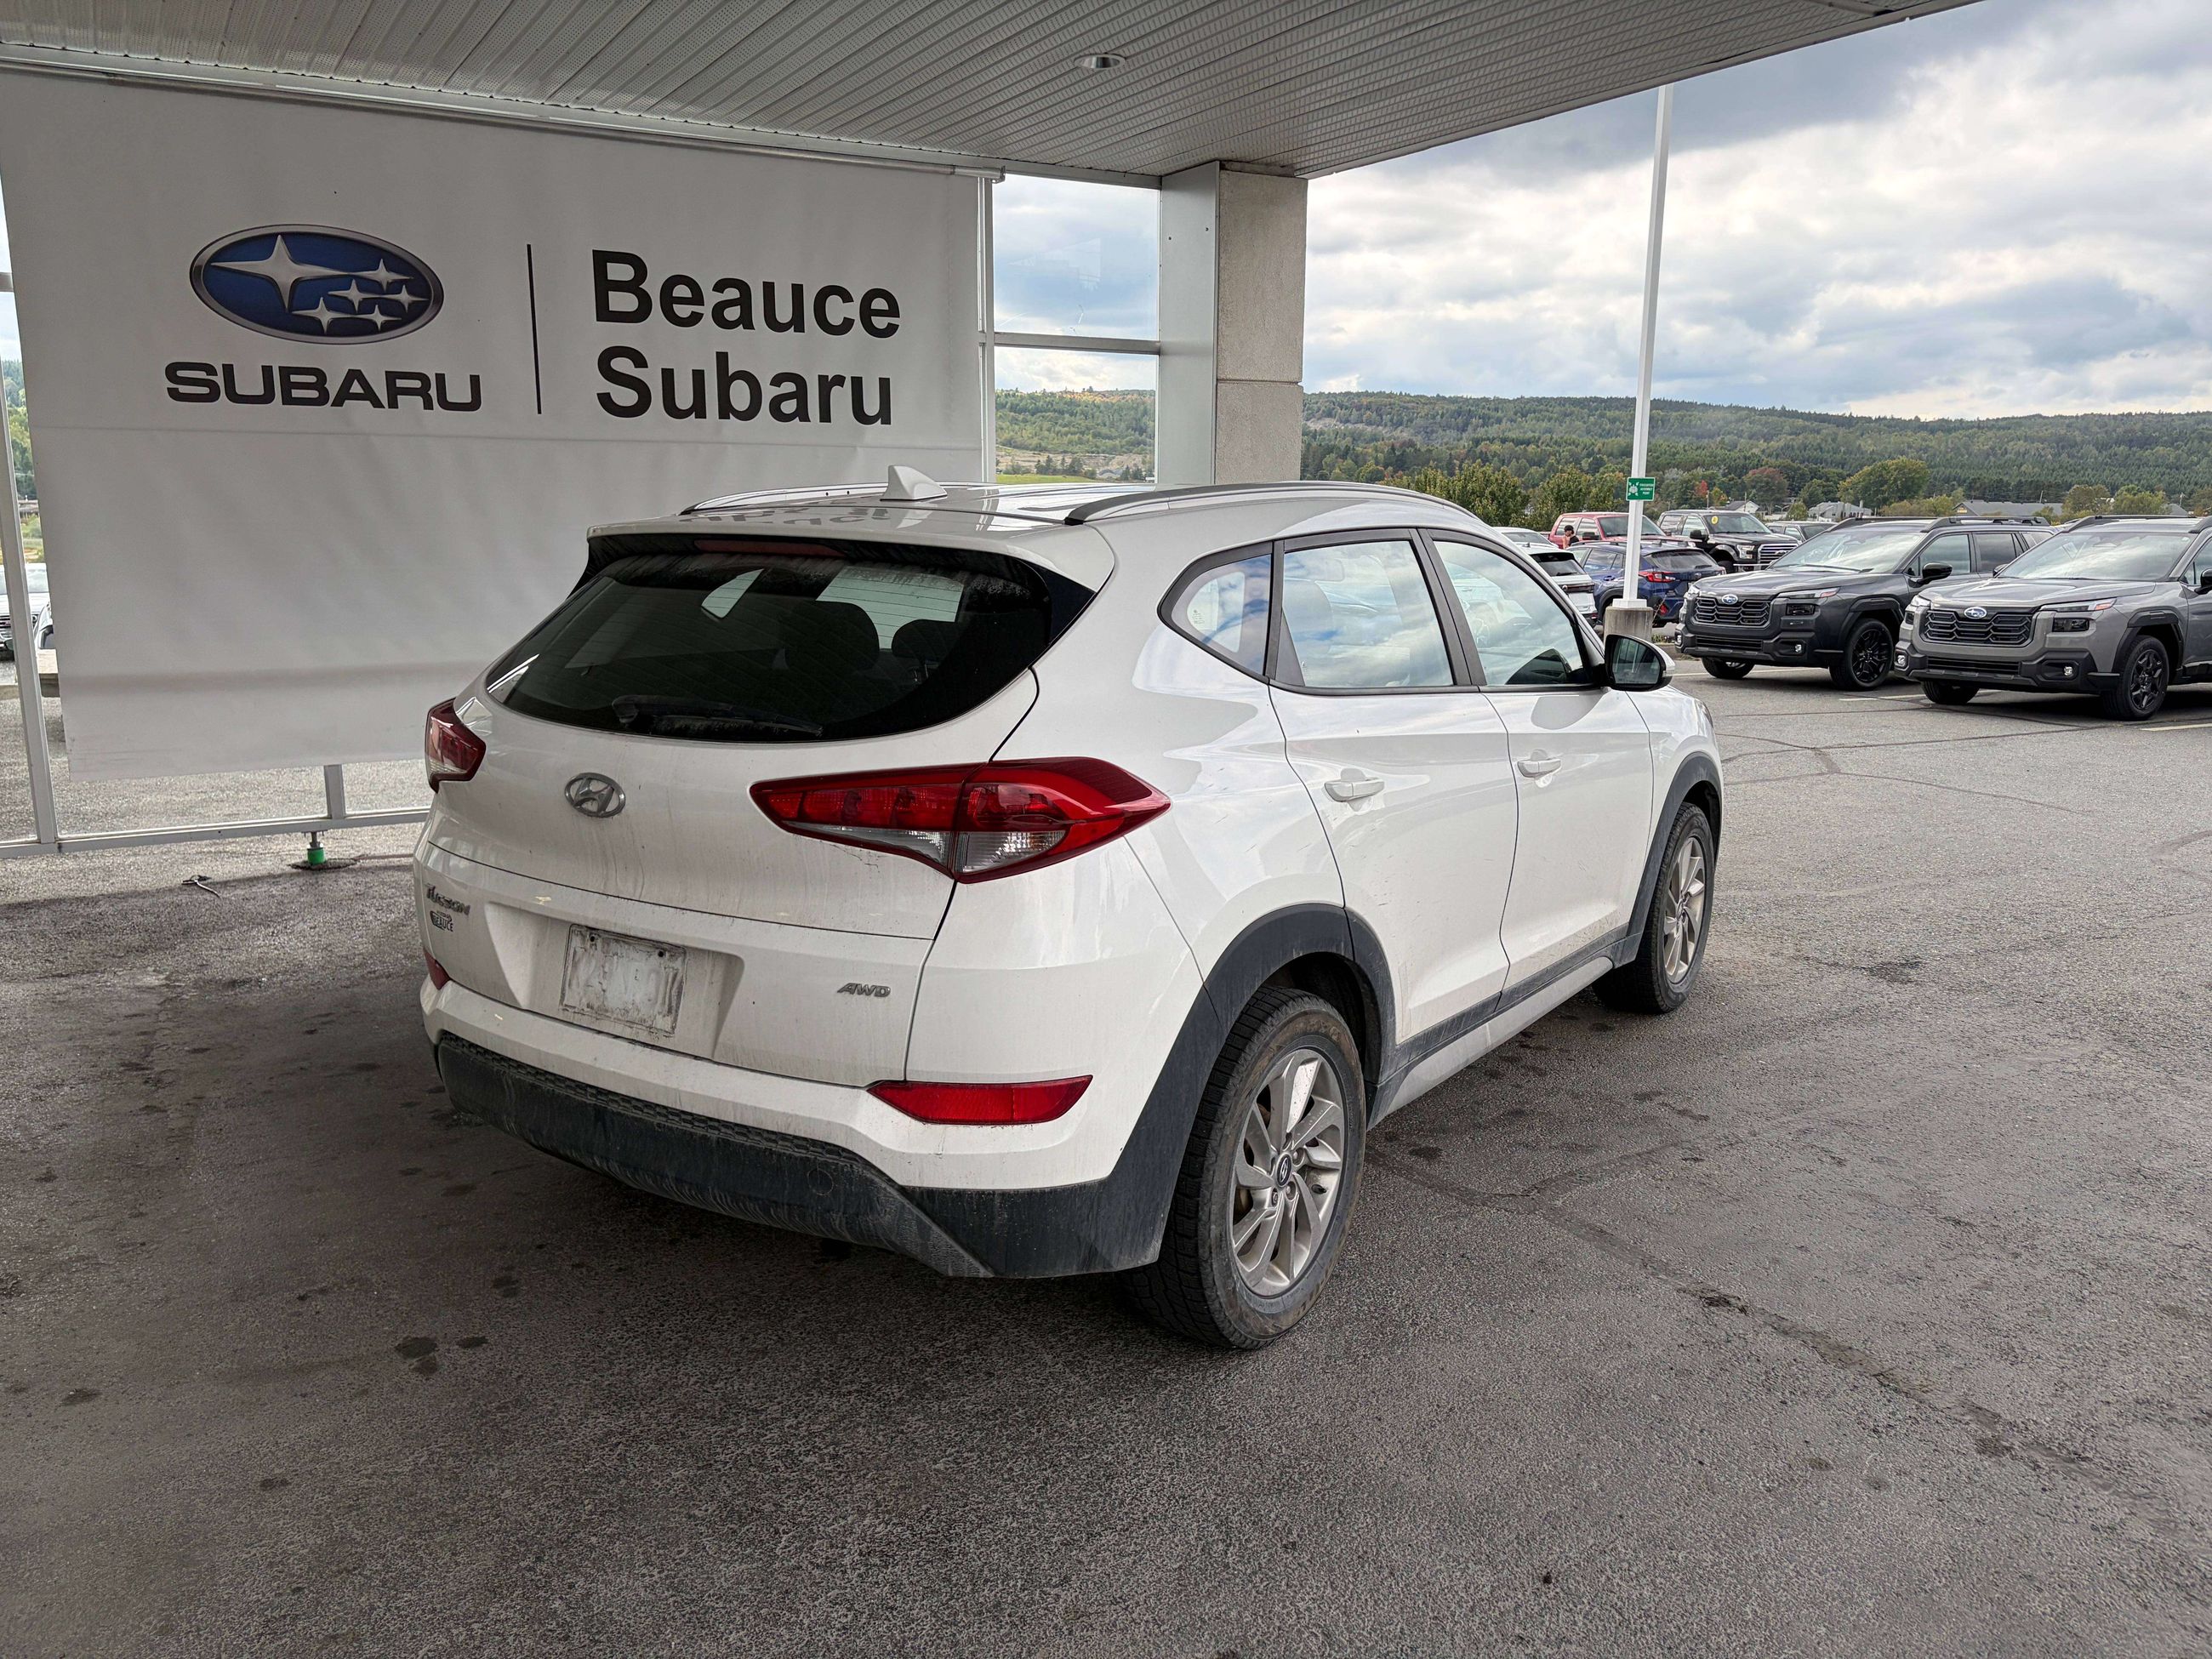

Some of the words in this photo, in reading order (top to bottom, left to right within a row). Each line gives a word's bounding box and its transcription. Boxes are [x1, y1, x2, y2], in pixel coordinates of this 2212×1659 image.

[592, 248, 901, 339] Beauce
[165, 361, 482, 412] SUBARU
[596, 345, 892, 425] Subaru
[836, 983, 891, 997] AWD
